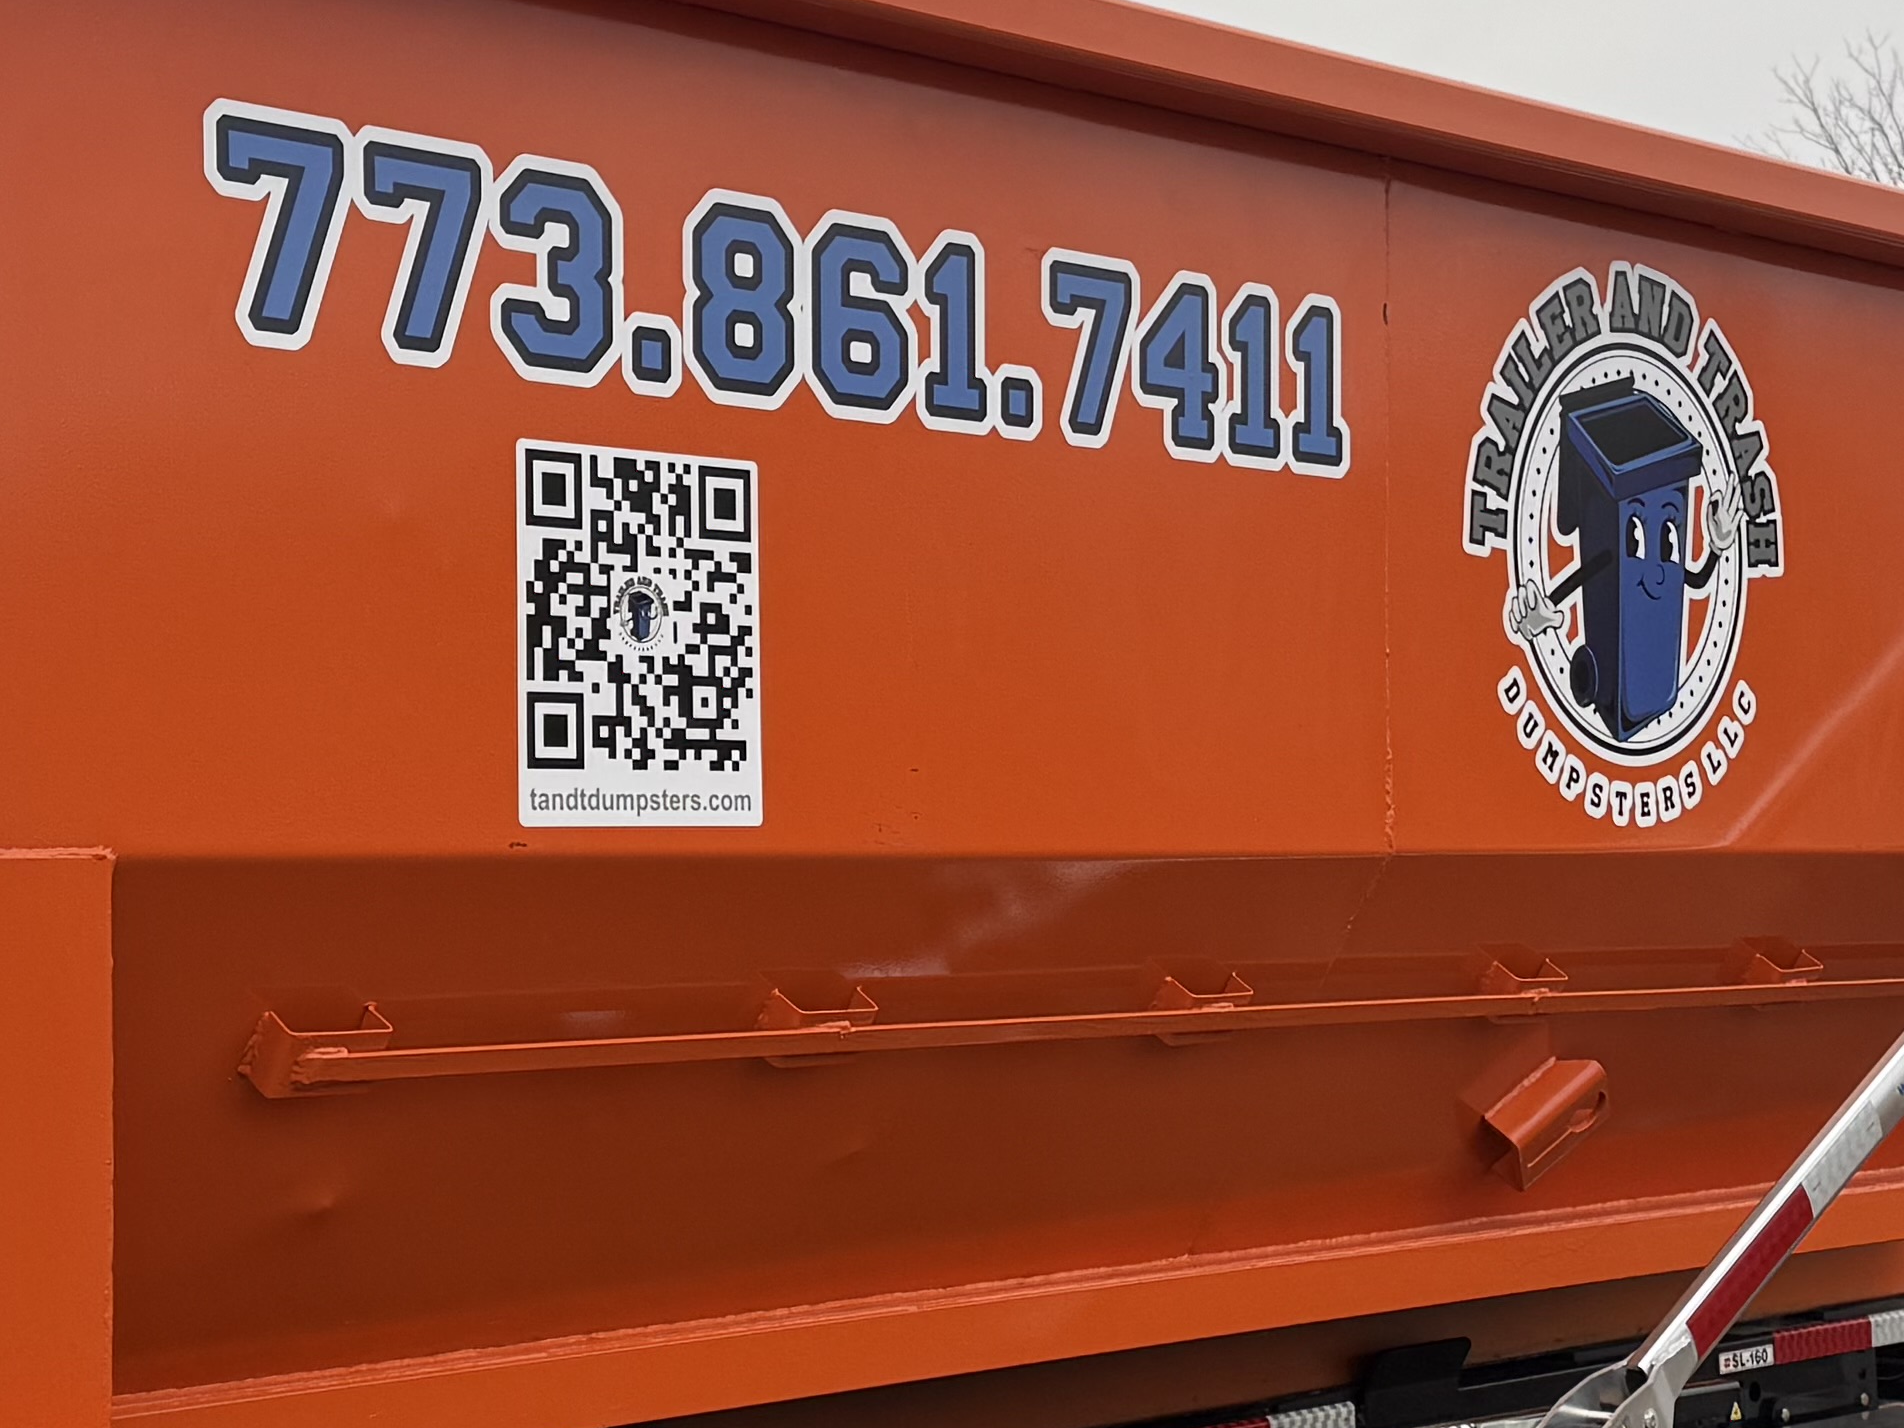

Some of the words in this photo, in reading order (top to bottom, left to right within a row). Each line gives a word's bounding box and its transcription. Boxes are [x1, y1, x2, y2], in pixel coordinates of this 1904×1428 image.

[204, 98, 1350, 477] 773.861.7411
[1470, 276, 1603, 547] TRAILER
[1610, 269, 1695, 356] AND
[1697, 325, 1779, 569] TRASH
[528, 786, 752, 818] tandtdumpsters.com
[1506, 677, 1698, 820] DUMPSTERS
[1707, 689, 1752, 775] LLC
